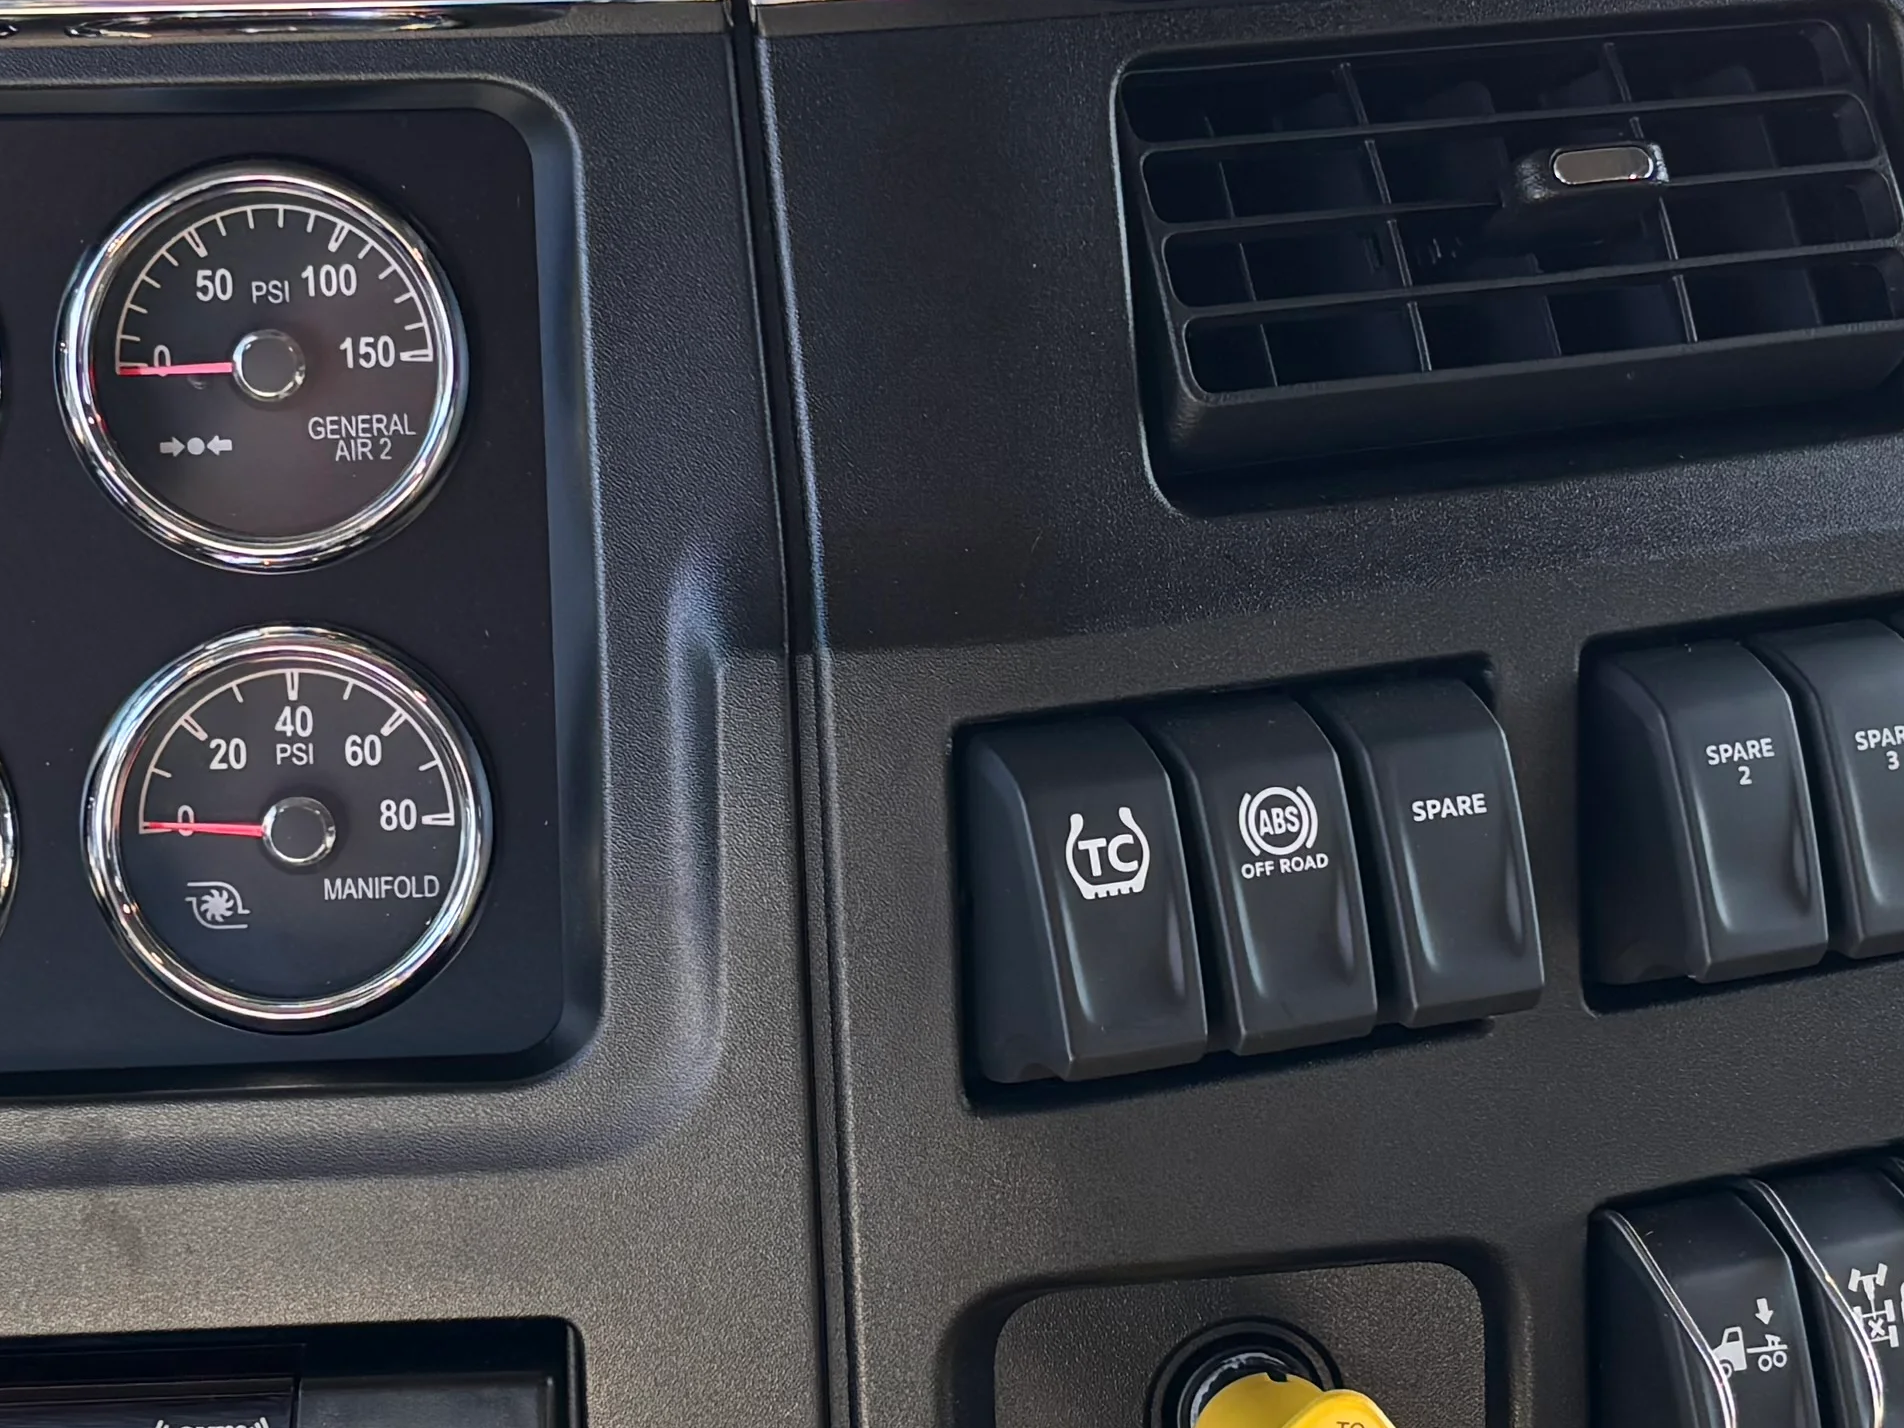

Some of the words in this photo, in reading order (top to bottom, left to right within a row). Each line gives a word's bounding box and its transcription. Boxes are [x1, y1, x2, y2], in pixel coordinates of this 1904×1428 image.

[196, 268, 233, 303] 50
[251, 280, 290, 304] PSI
[301, 265, 357, 297] 100
[340, 336, 395, 369] 150
[308, 414, 417, 440] GENERAL
[334, 439, 373, 461] AIR
[379, 438, 393, 460] 2
[275, 705, 313, 737] 40
[209, 738, 248, 770] 20
[276, 743, 315, 765] PSI
[344, 734, 382, 766] 60
[1706, 736, 1775, 767] SPARE
[1886, 749, 1900, 771] 3
[1738, 765, 1753, 787] 2
[176, 804, 195, 837] 0
[380, 799, 417, 831] 80
[1258, 804, 1300, 838] ABS
[1411, 793, 1488, 823] SPARE
[1078, 833, 1139, 877] TC
[1241, 861, 1276, 880] OFF
[1279, 853, 1329, 875] ROAD
[323, 875, 440, 900] MANIFOLD
